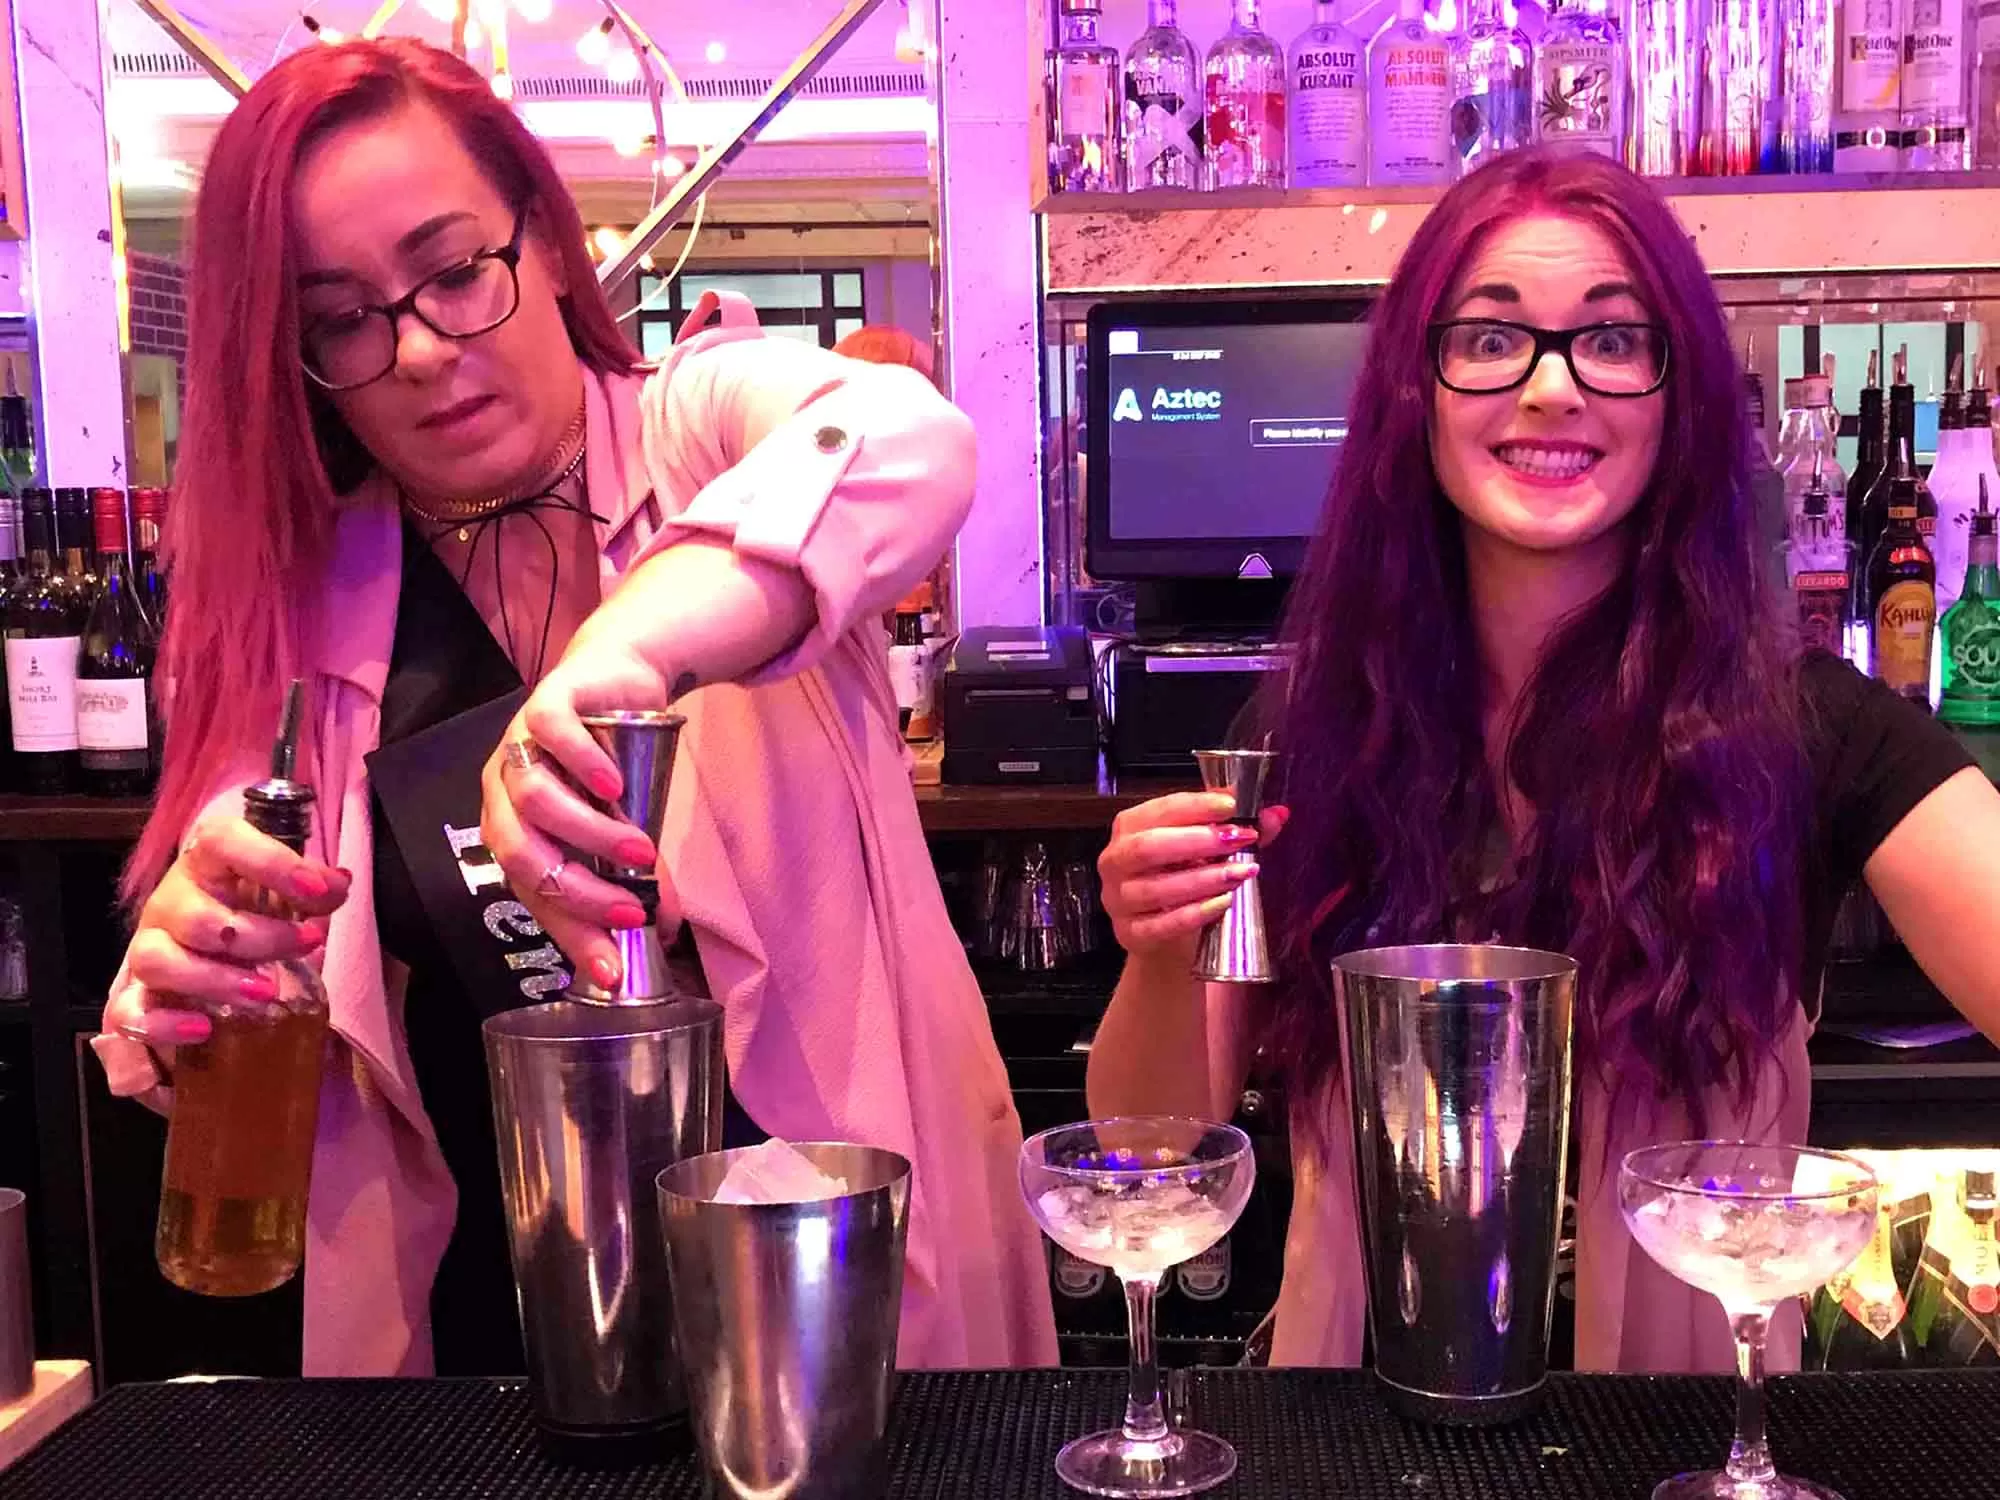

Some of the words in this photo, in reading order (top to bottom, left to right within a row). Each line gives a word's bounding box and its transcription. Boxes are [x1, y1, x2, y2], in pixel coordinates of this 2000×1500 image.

[1297, 52, 1356, 70] ABSOLUT
[1299, 73, 1354, 90] KURANT
[1151, 387, 1221, 408] Aztec
